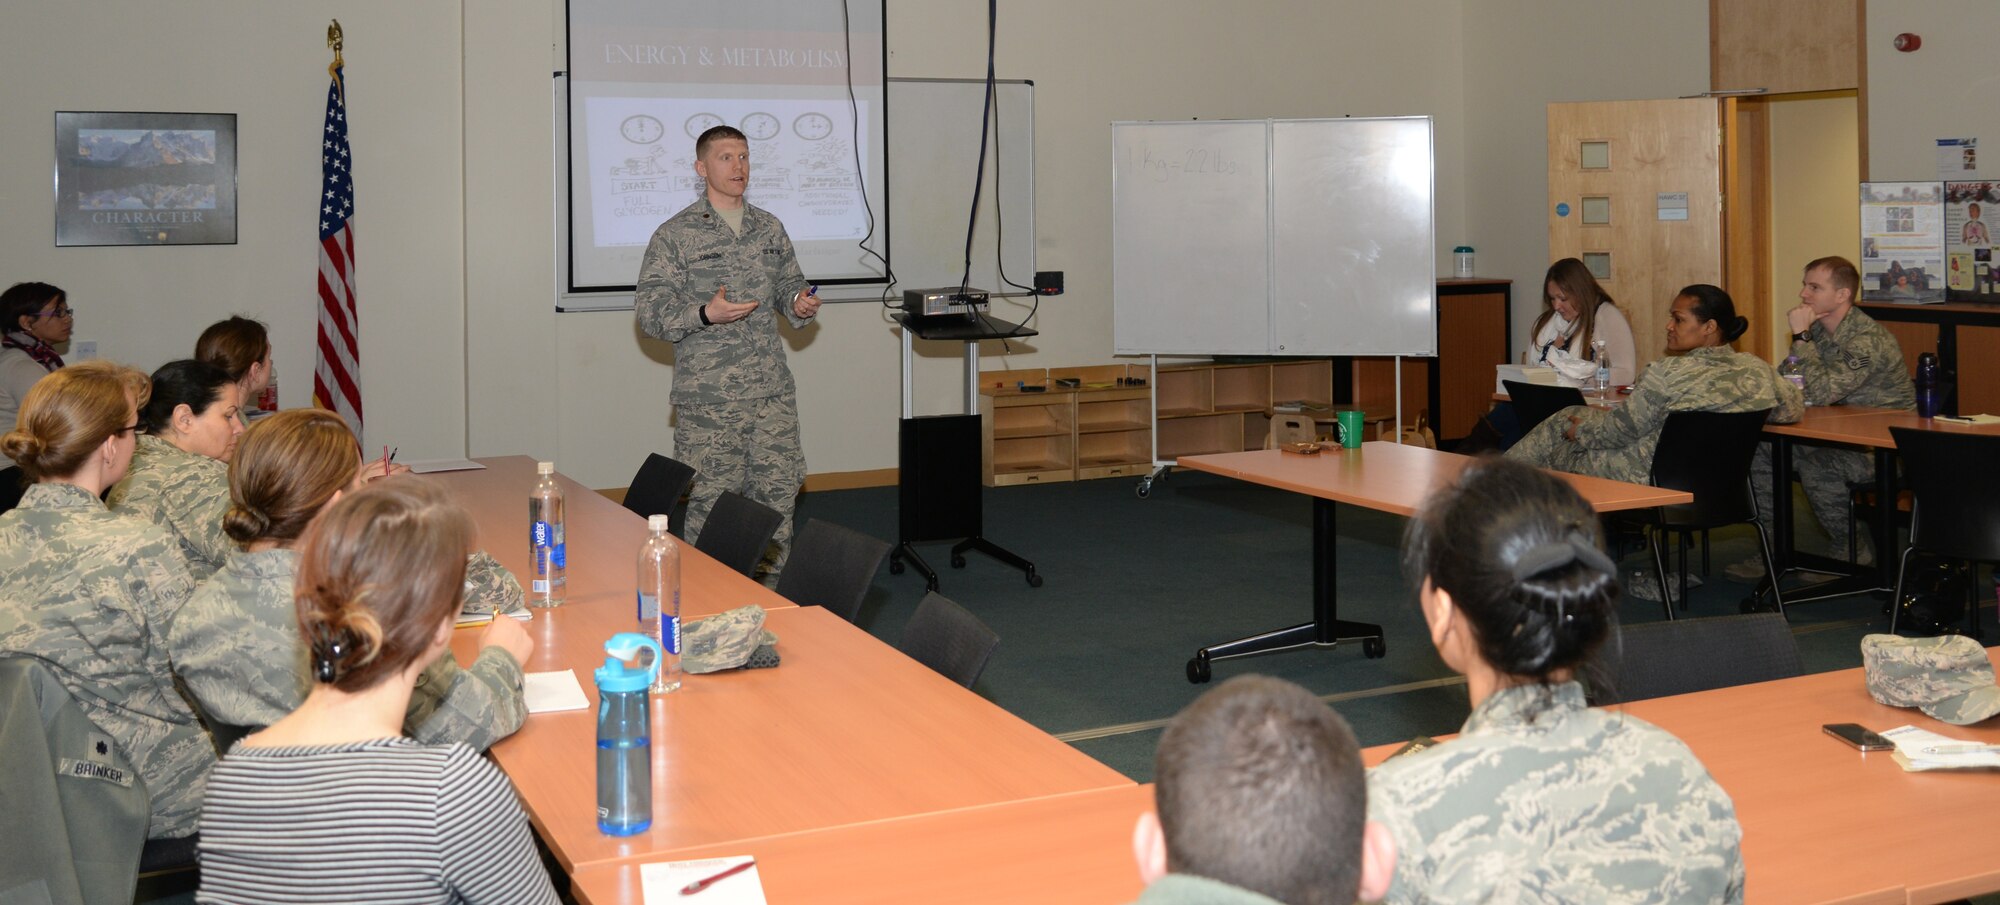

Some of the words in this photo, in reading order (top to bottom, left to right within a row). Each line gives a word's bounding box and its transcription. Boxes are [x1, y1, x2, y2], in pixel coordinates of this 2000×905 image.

[604, 43, 691, 65] ENERGY
[698, 46, 714, 66] &
[721, 47, 848, 68] METABOLISM
[92, 211, 204, 224] CHARACTER
[74, 762, 123, 782] BRINKER
